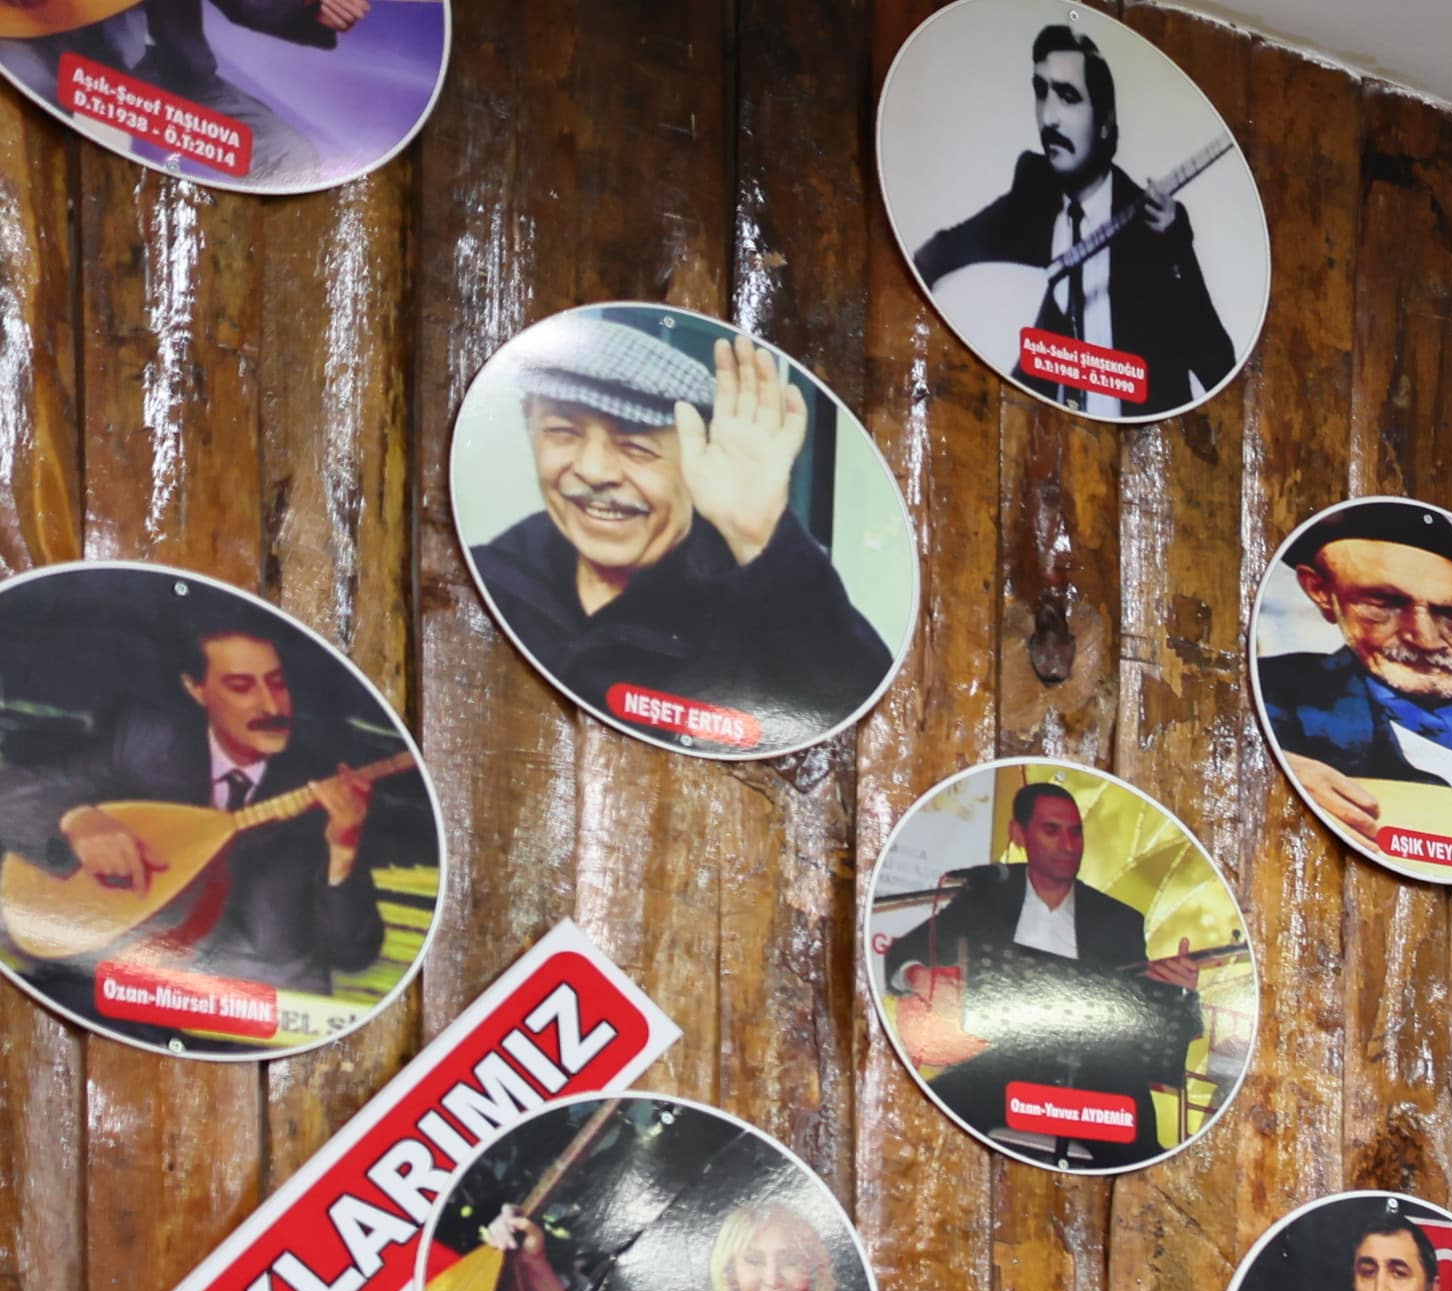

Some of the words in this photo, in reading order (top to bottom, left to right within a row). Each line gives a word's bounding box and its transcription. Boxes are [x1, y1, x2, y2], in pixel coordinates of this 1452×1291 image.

[72, 67, 161, 115] Aşık-Şeref
[74, 90, 149, 132] D.T:1938
[624, 691, 685, 725] NEŞET
[688, 707, 745, 745] ERTAŞ
[1390, 834, 1425, 857] AŞIK
[103, 978, 217, 1015] Ozan-Mürsel
[1011, 1098, 1080, 1120] Ozan-Yavuz
[1081, 1108, 1135, 1128] AYDEMİR
